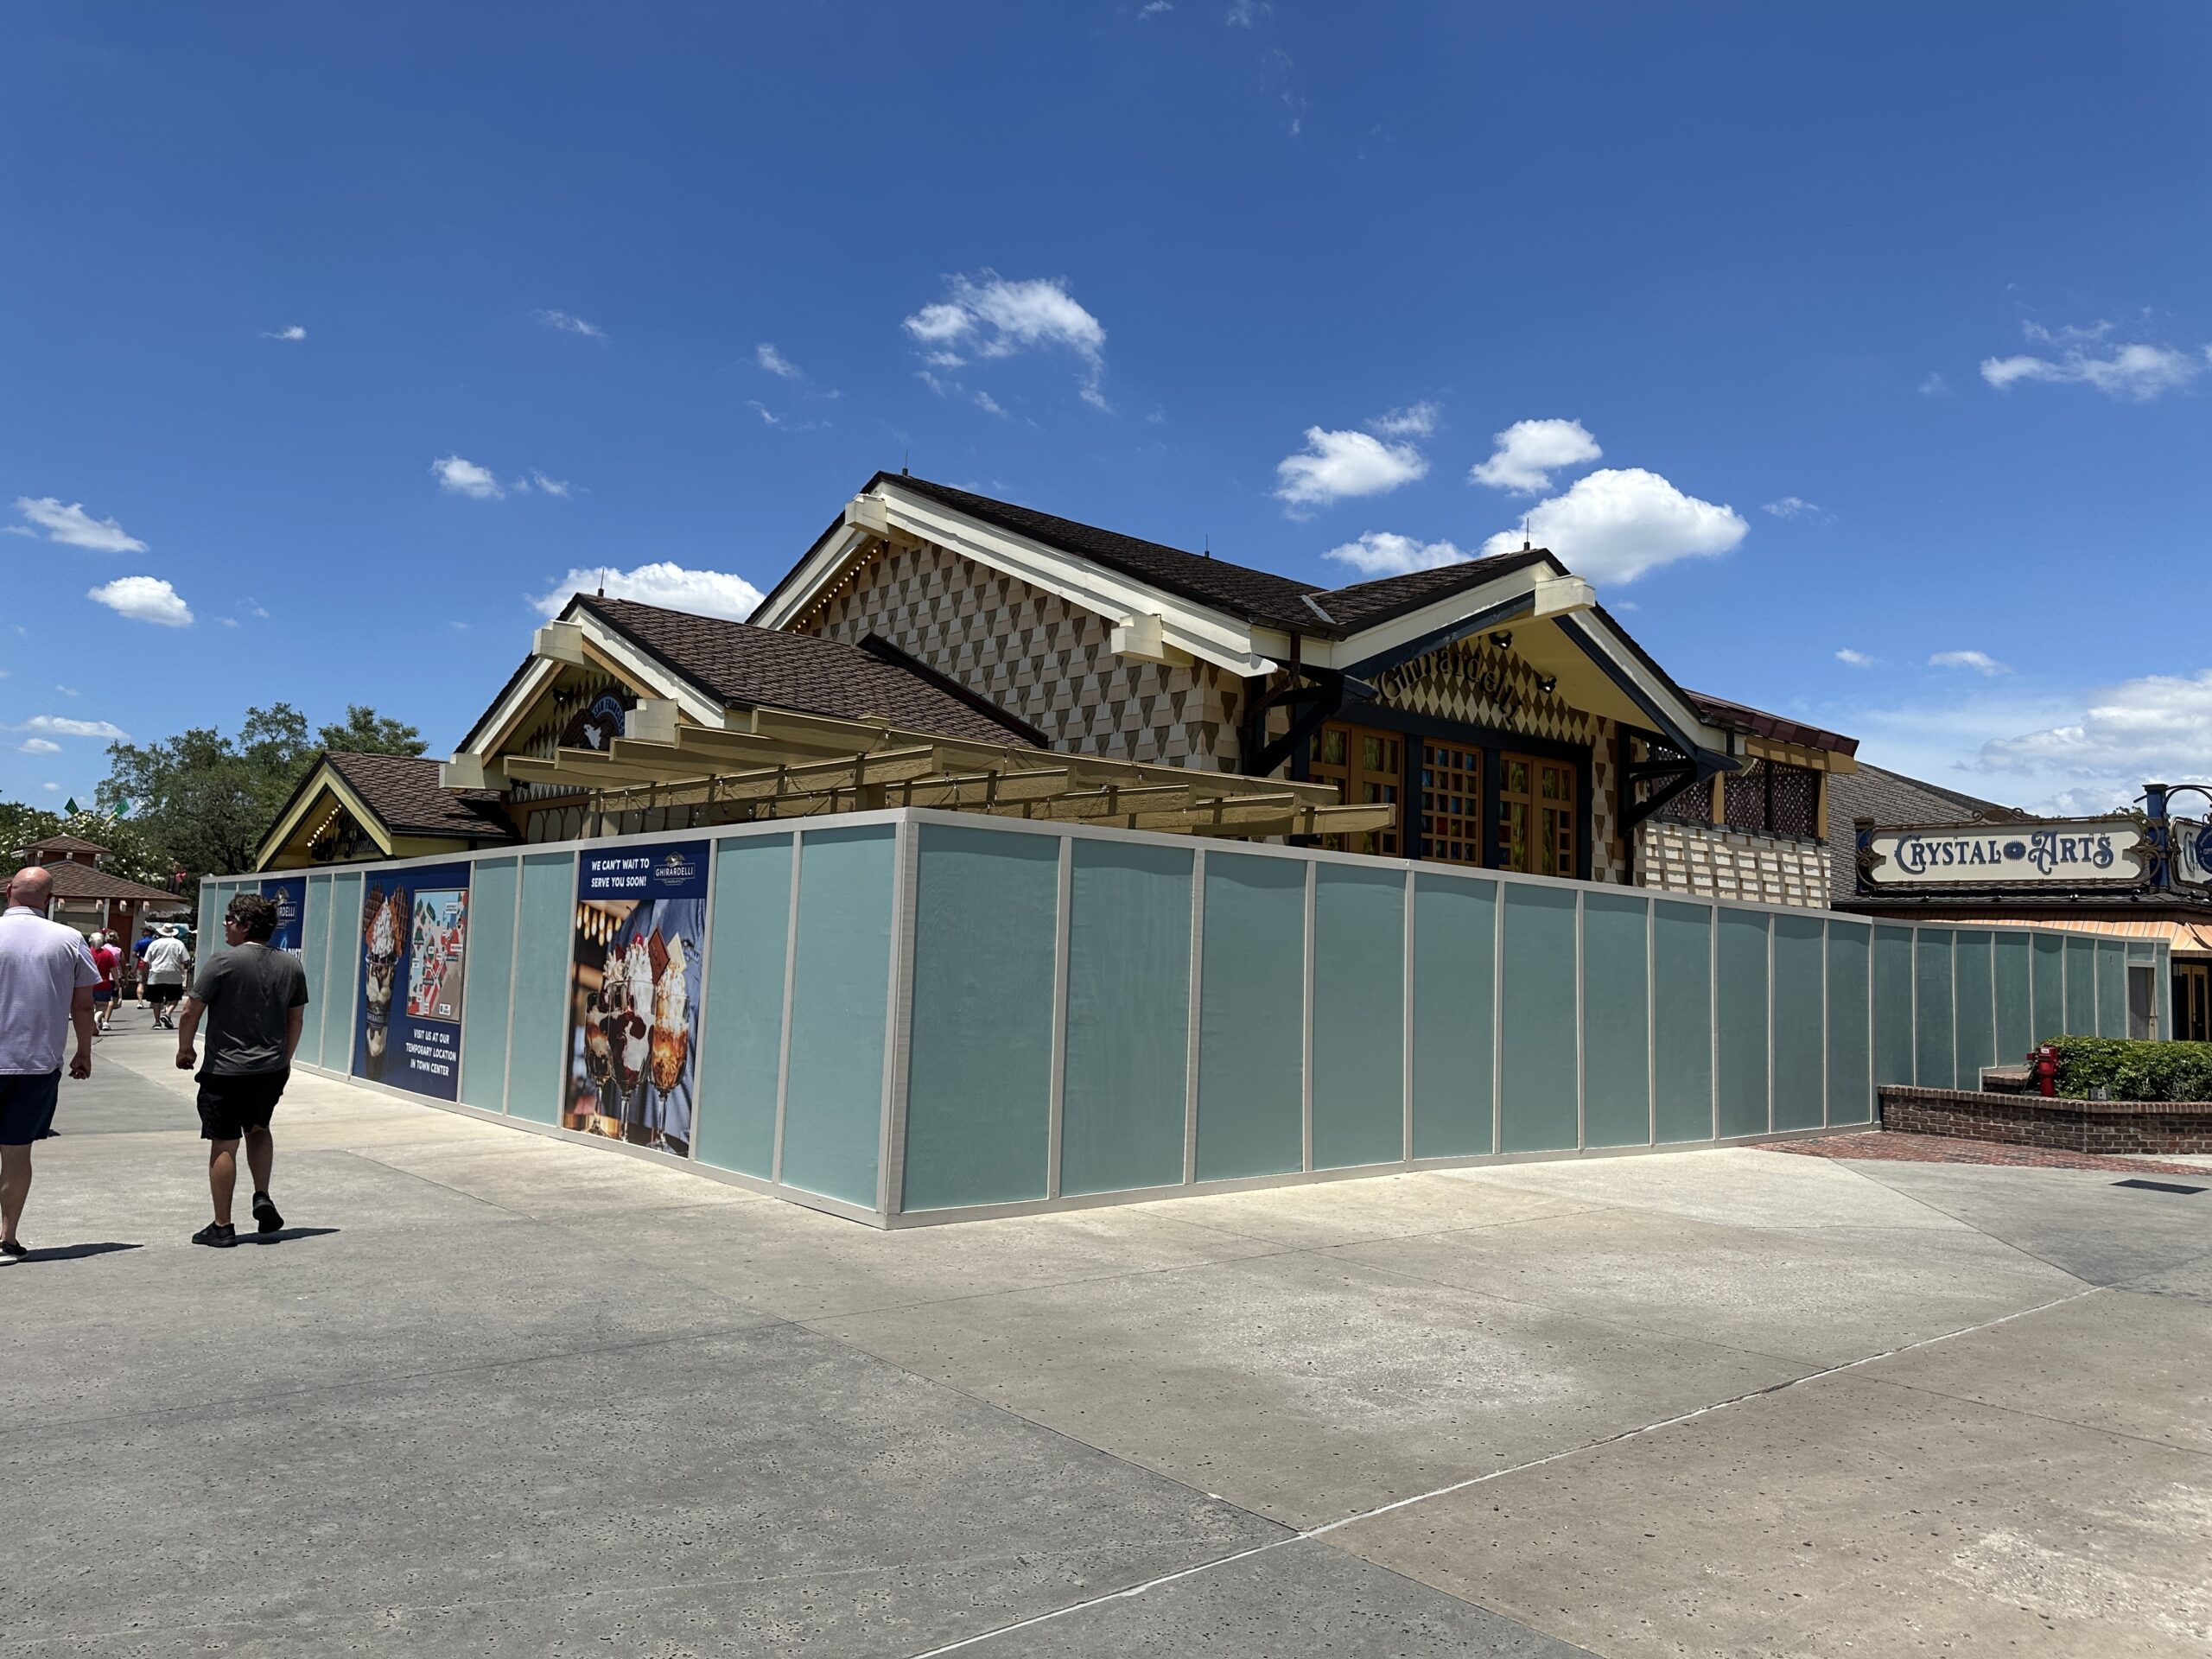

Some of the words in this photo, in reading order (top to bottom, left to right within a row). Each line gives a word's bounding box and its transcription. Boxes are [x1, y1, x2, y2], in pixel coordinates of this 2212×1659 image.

[594, 700, 604, 717] SAN
[1894, 834, 2002, 875] CRYSTAL
[2028, 830, 2114, 875] ARTS
[591, 861, 601, 871] WE
[602, 859, 621, 871] CAN'T
[622, 858, 639, 870] WAIT
[640, 857, 650, 869] TO
[656, 867, 693, 876] GHIRARDELLI
[591, 877, 610, 888] SERVE
[611, 876, 626, 887] YOU
[626, 875, 647, 887] SOON!
[413, 1028, 425, 1039] VISIT
[424, 1030, 432, 1041] US
[432, 1032, 439, 1043] AT
[439, 1033, 450, 1045] OUR
[406, 1042, 432, 1057] TEMPORARY
[433, 1047, 456, 1062] LOCATION
[410, 1058, 416, 1069] IN
[416, 1059, 430, 1072] TOWN
[430, 1063, 449, 1077] CENTER
